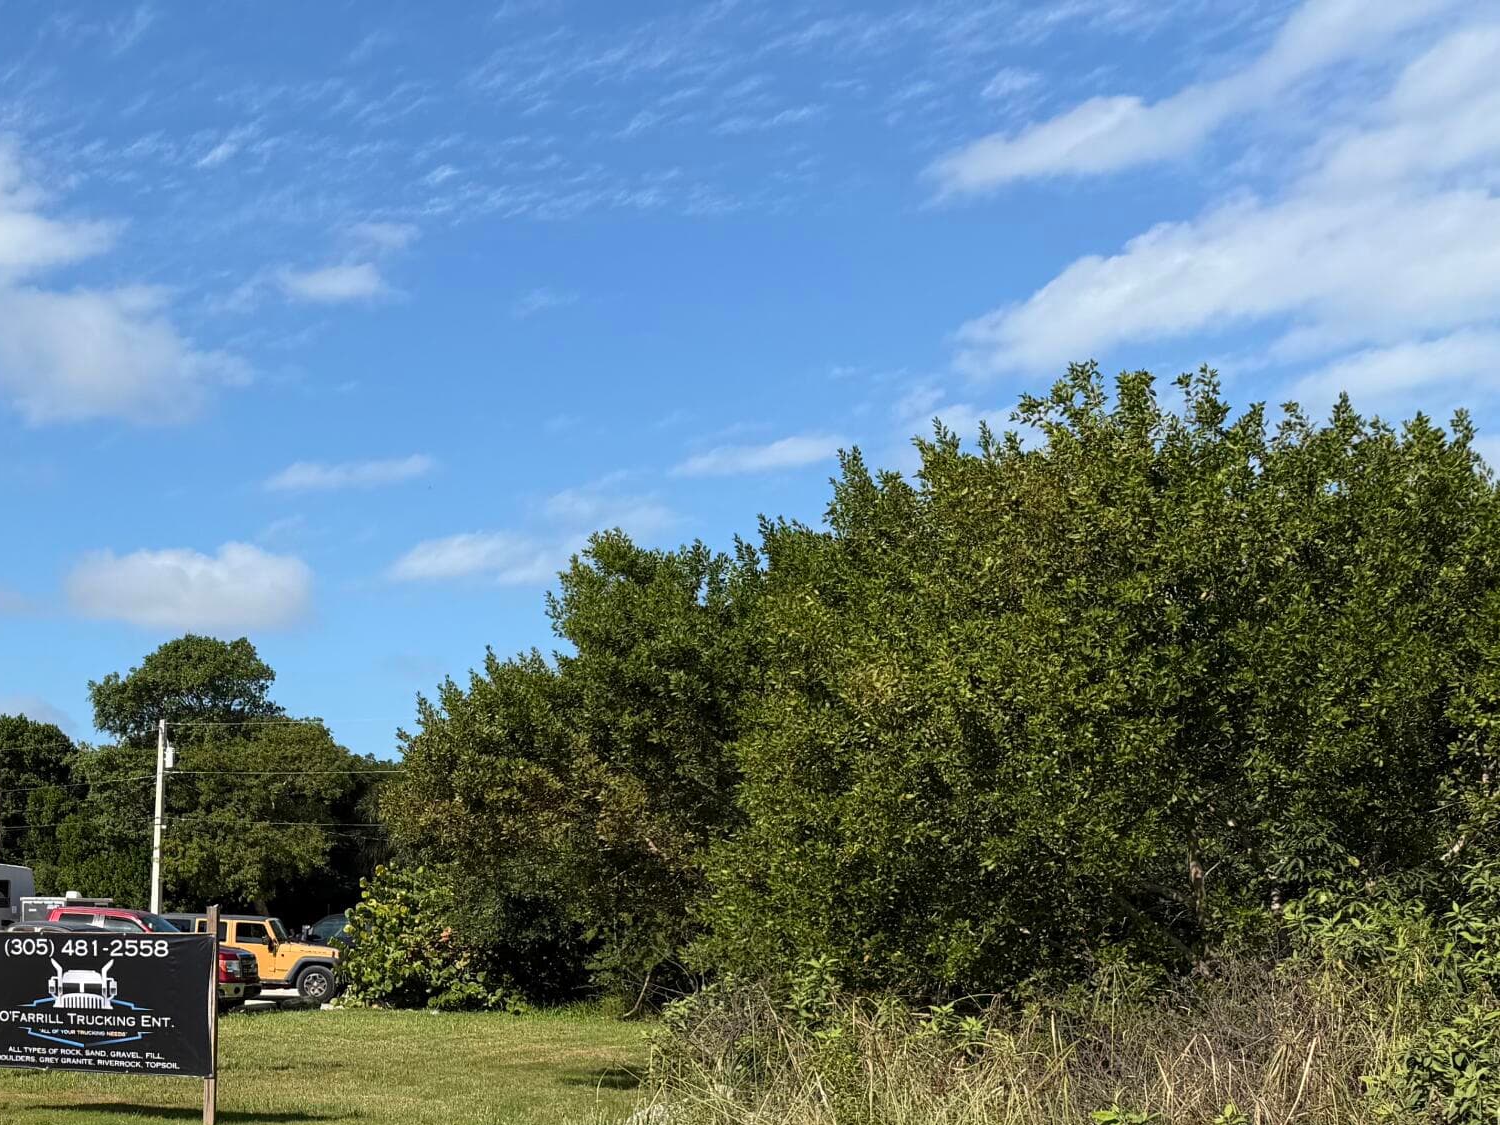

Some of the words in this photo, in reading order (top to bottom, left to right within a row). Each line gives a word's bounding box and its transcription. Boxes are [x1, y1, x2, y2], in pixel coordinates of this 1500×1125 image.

[4, 938, 56, 958] (305)
[60, 939, 170, 958] 481-2558
[67, 1012, 136, 1027] TRUCKING
[141, 1015, 176, 1028] ENT.
[23, 1046, 47, 1054] TYPES
[39, 1056, 59, 1064] GREY
